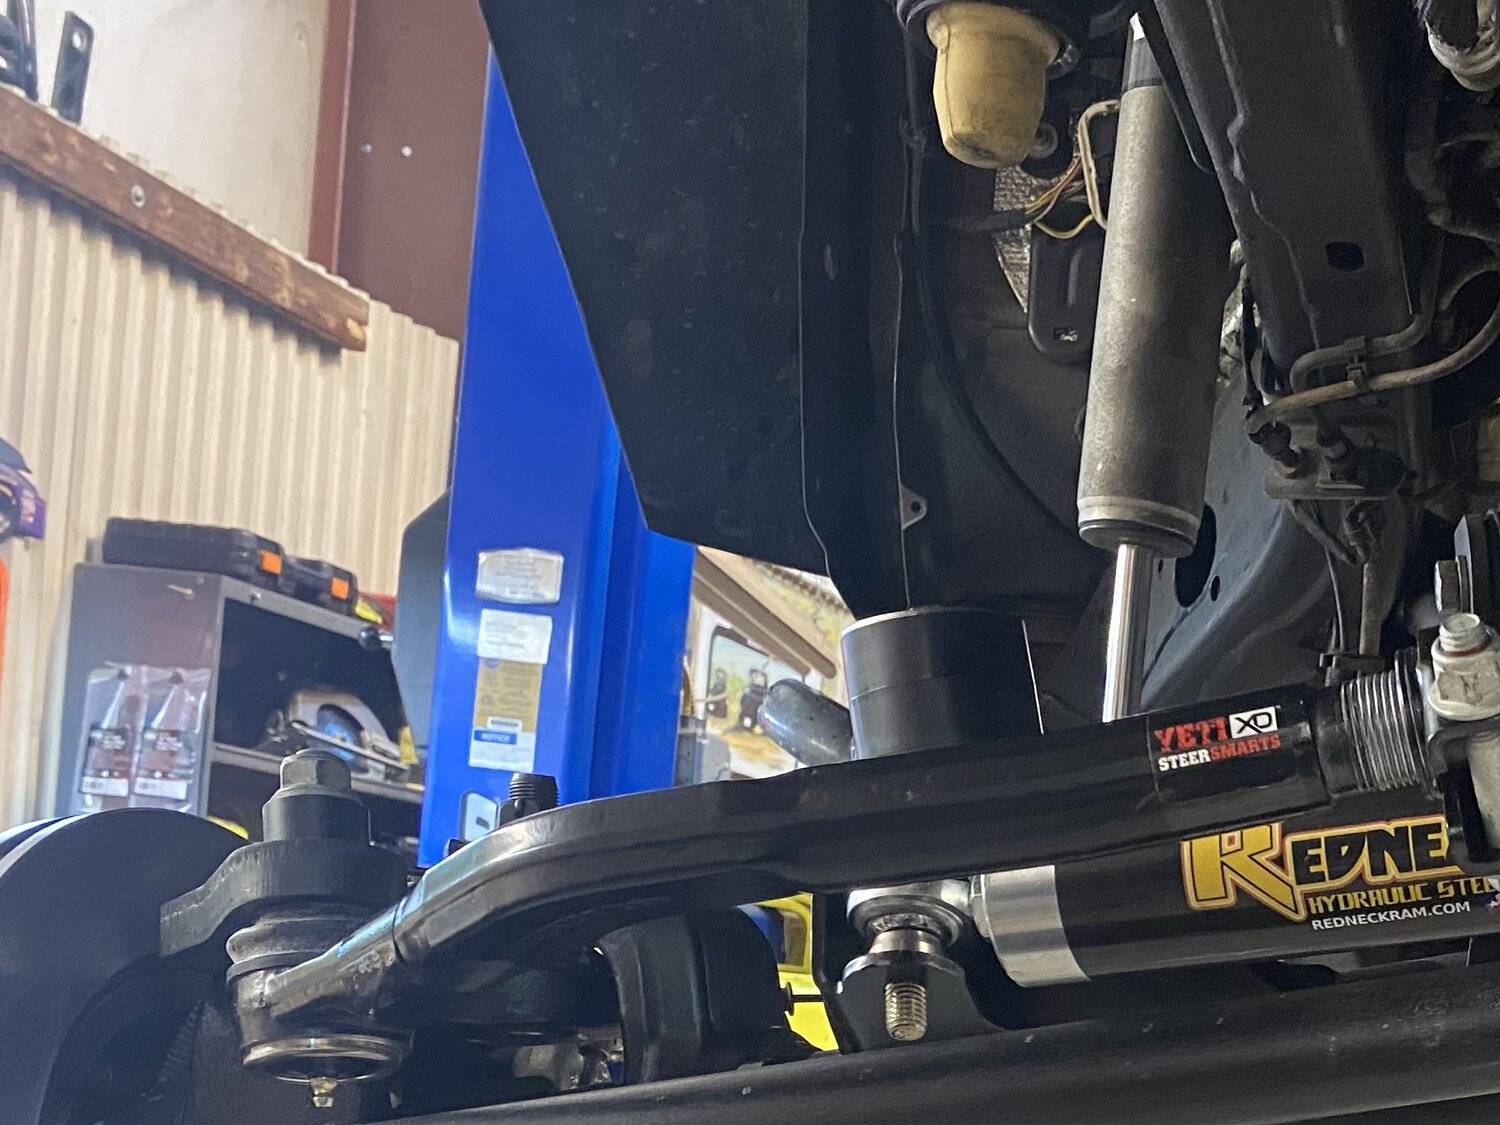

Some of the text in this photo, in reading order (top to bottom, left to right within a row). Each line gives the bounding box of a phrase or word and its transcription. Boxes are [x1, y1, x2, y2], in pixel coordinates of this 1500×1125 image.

[1153, 716, 1228, 752] YETI
[1180, 814, 1457, 922] REDNE
[1307, 882, 1432, 915] HYDRAULIC
[1311, 901, 1471, 931] REDNECKRAM.COM
